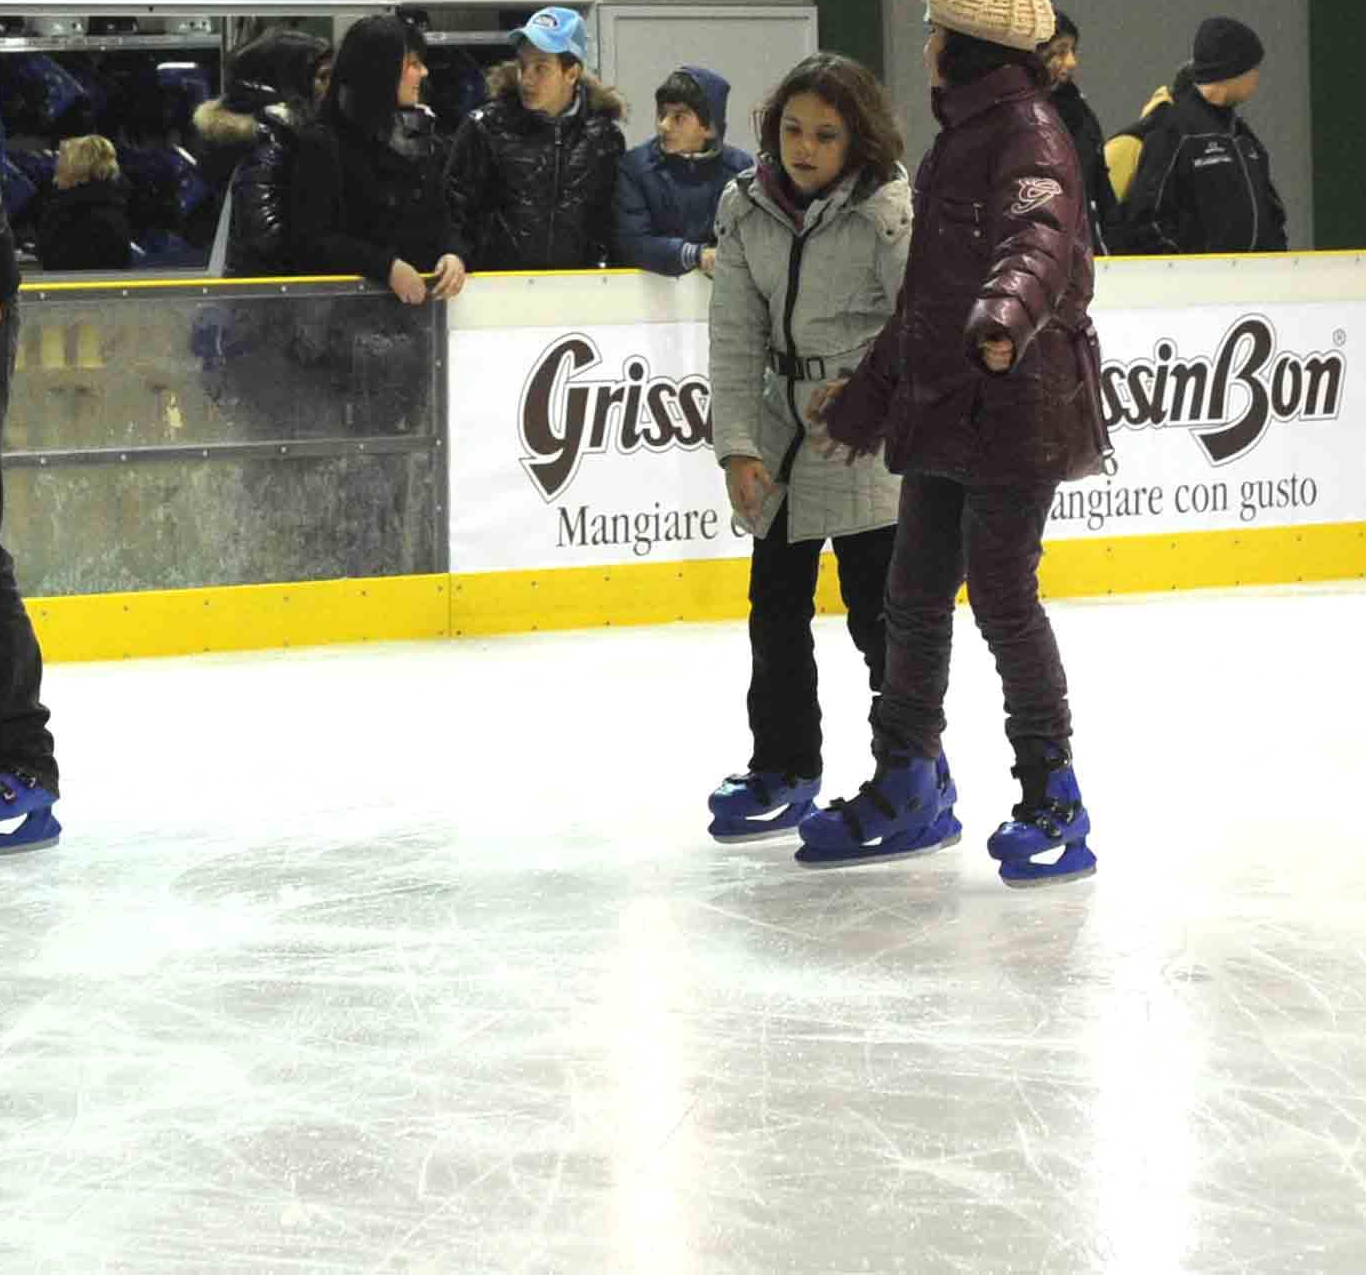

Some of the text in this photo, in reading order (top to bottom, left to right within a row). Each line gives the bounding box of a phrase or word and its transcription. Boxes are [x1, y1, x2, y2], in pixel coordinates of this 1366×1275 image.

[520, 336, 714, 501] Griss
[556, 502, 718, 556] Mangiare
[1050, 473, 1318, 531] angiare con gusto
